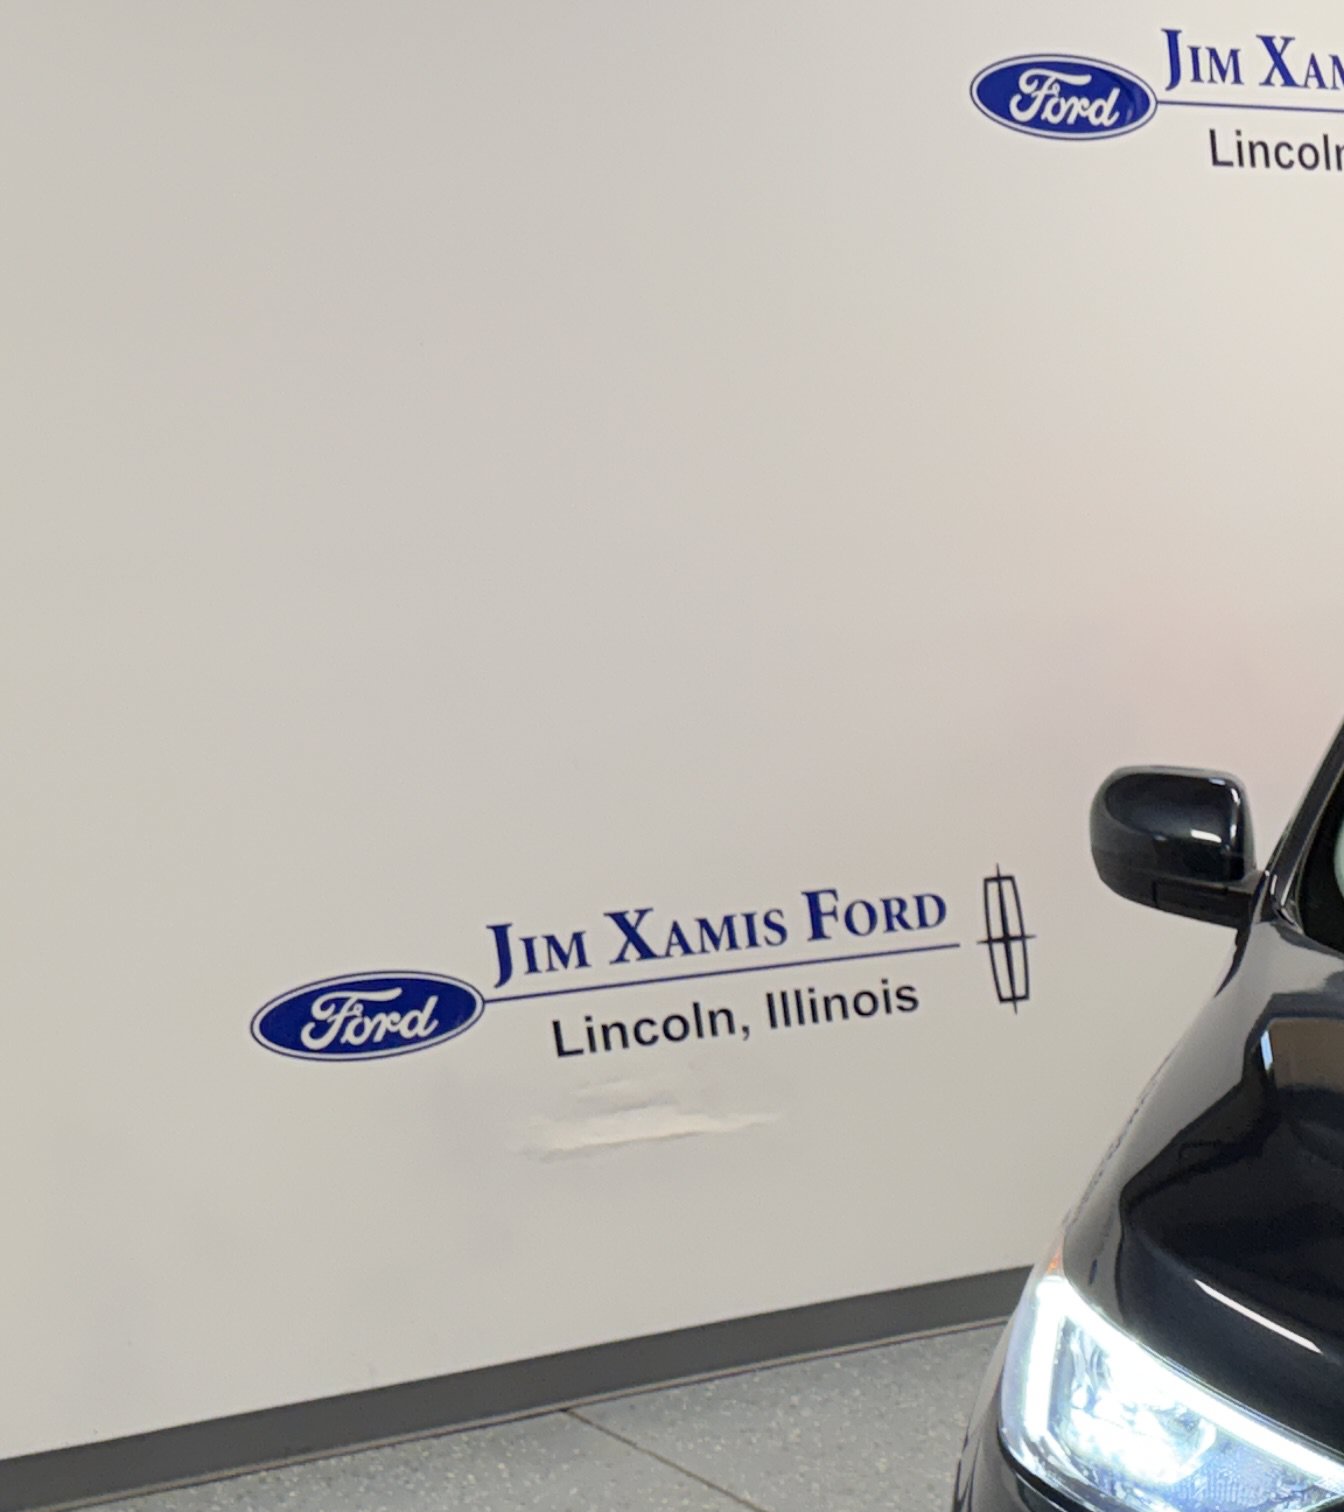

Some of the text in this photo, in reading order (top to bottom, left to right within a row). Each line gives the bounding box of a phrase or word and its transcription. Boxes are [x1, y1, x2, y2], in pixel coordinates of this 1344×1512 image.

[1161, 29, 1242, 91] JIM
[1009, 68, 1121, 127] Ford
[486, 888, 947, 987] JIM XAMIS FORD
[300, 987, 438, 1051] Ford
[553, 979, 919, 1057] Lincoln, Illinois
